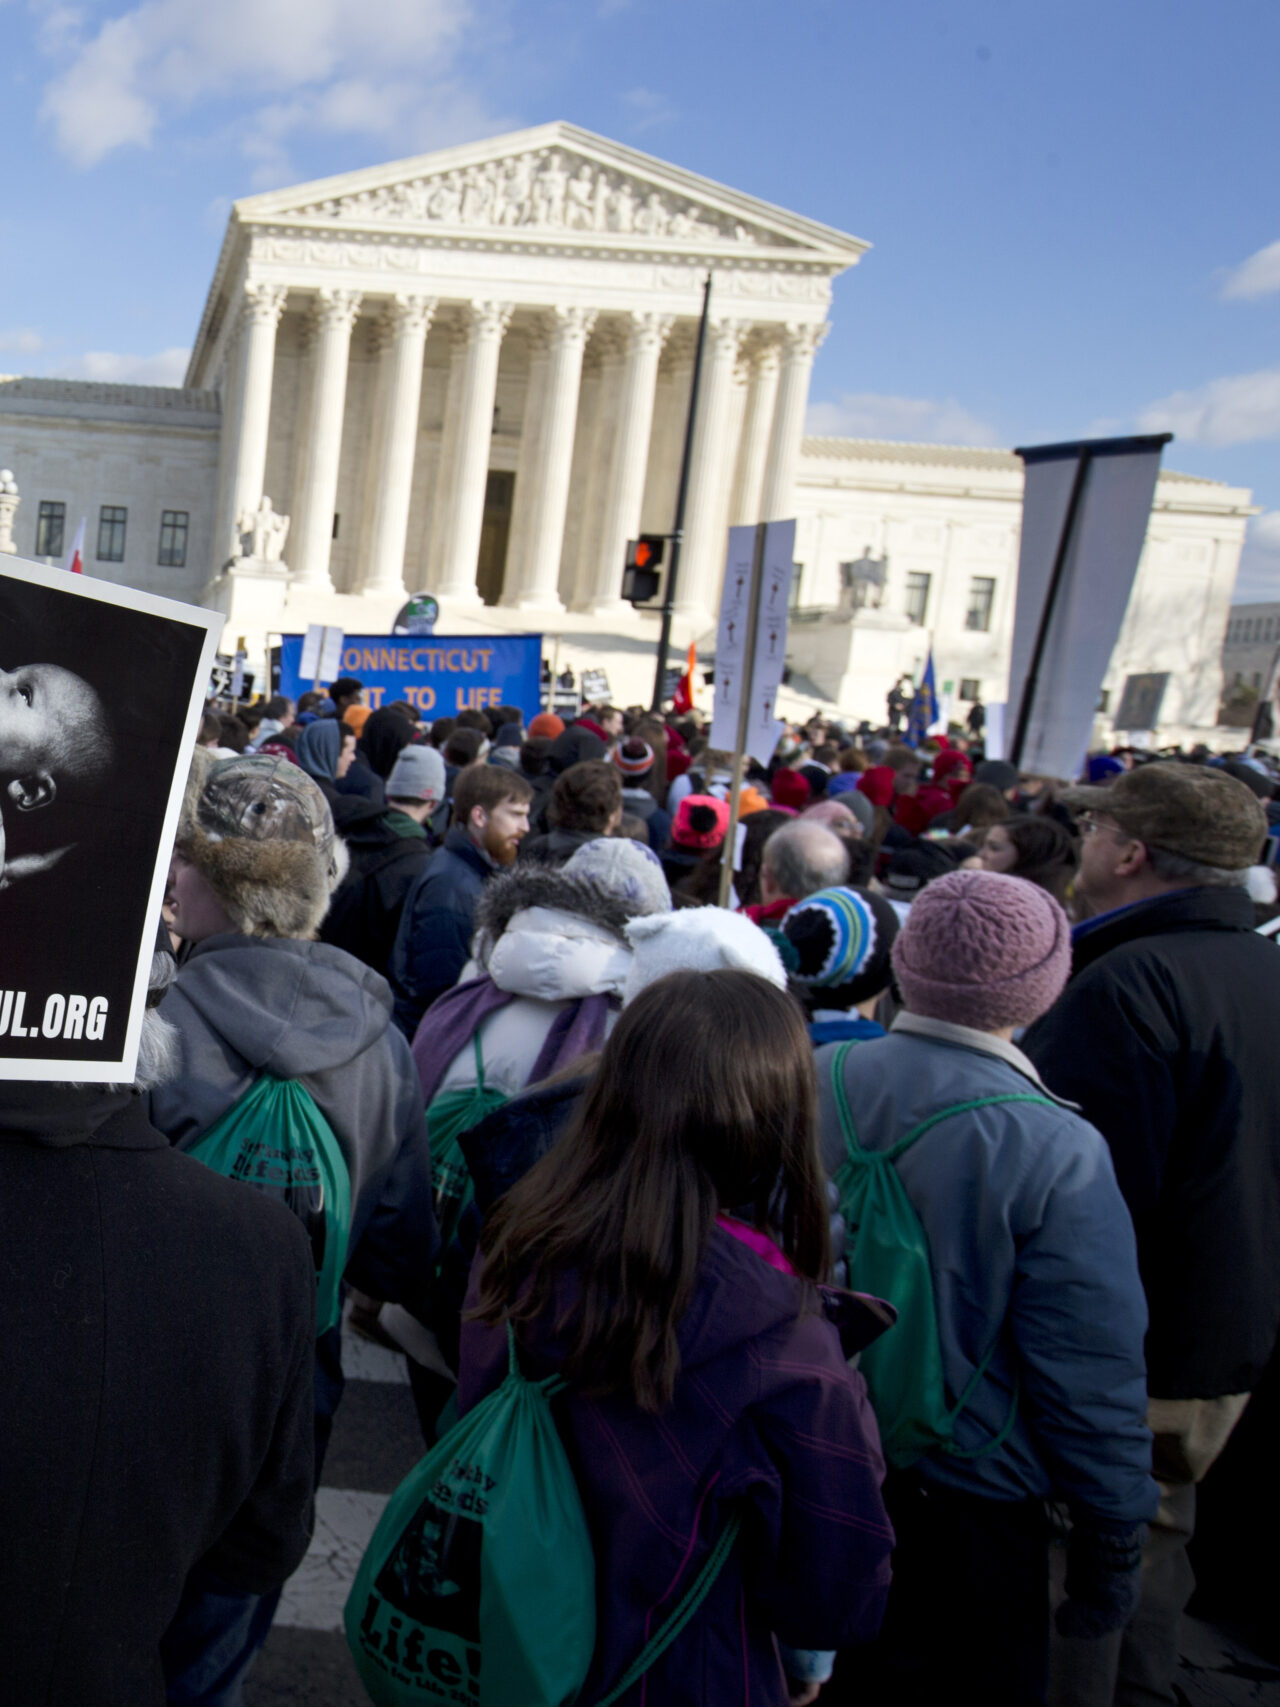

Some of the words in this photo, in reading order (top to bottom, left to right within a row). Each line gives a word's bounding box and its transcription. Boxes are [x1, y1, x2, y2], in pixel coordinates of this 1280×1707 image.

[338, 647, 494, 673] ONNECTICUT
[403, 685, 437, 711] TO
[456, 687, 503, 712] LIFE
[361, 1592, 482, 1697] Life!
